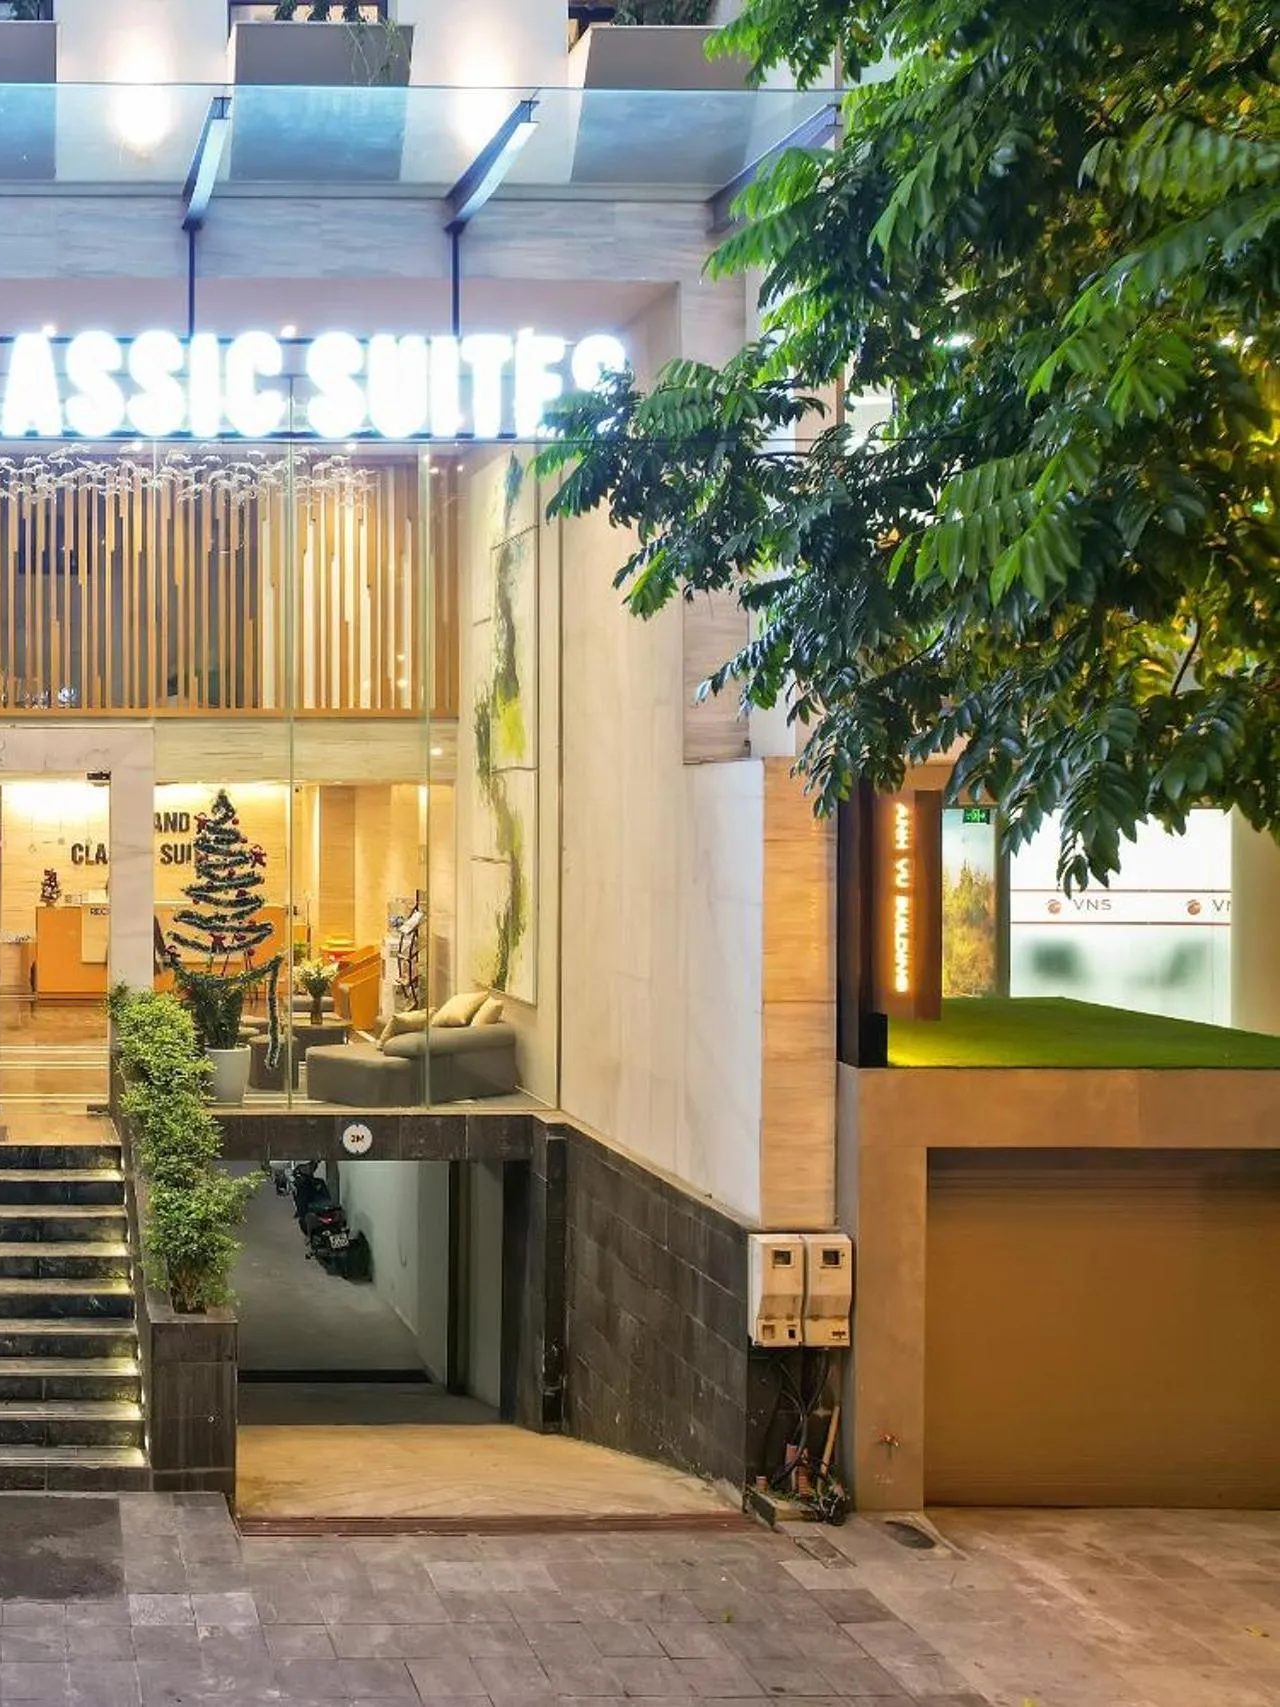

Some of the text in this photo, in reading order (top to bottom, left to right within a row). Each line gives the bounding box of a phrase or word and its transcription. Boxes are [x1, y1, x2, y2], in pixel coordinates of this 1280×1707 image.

[153, 811, 190, 833] AND
[71, 842, 108, 866] CLA
[1072, 898, 1113, 912] VNS
